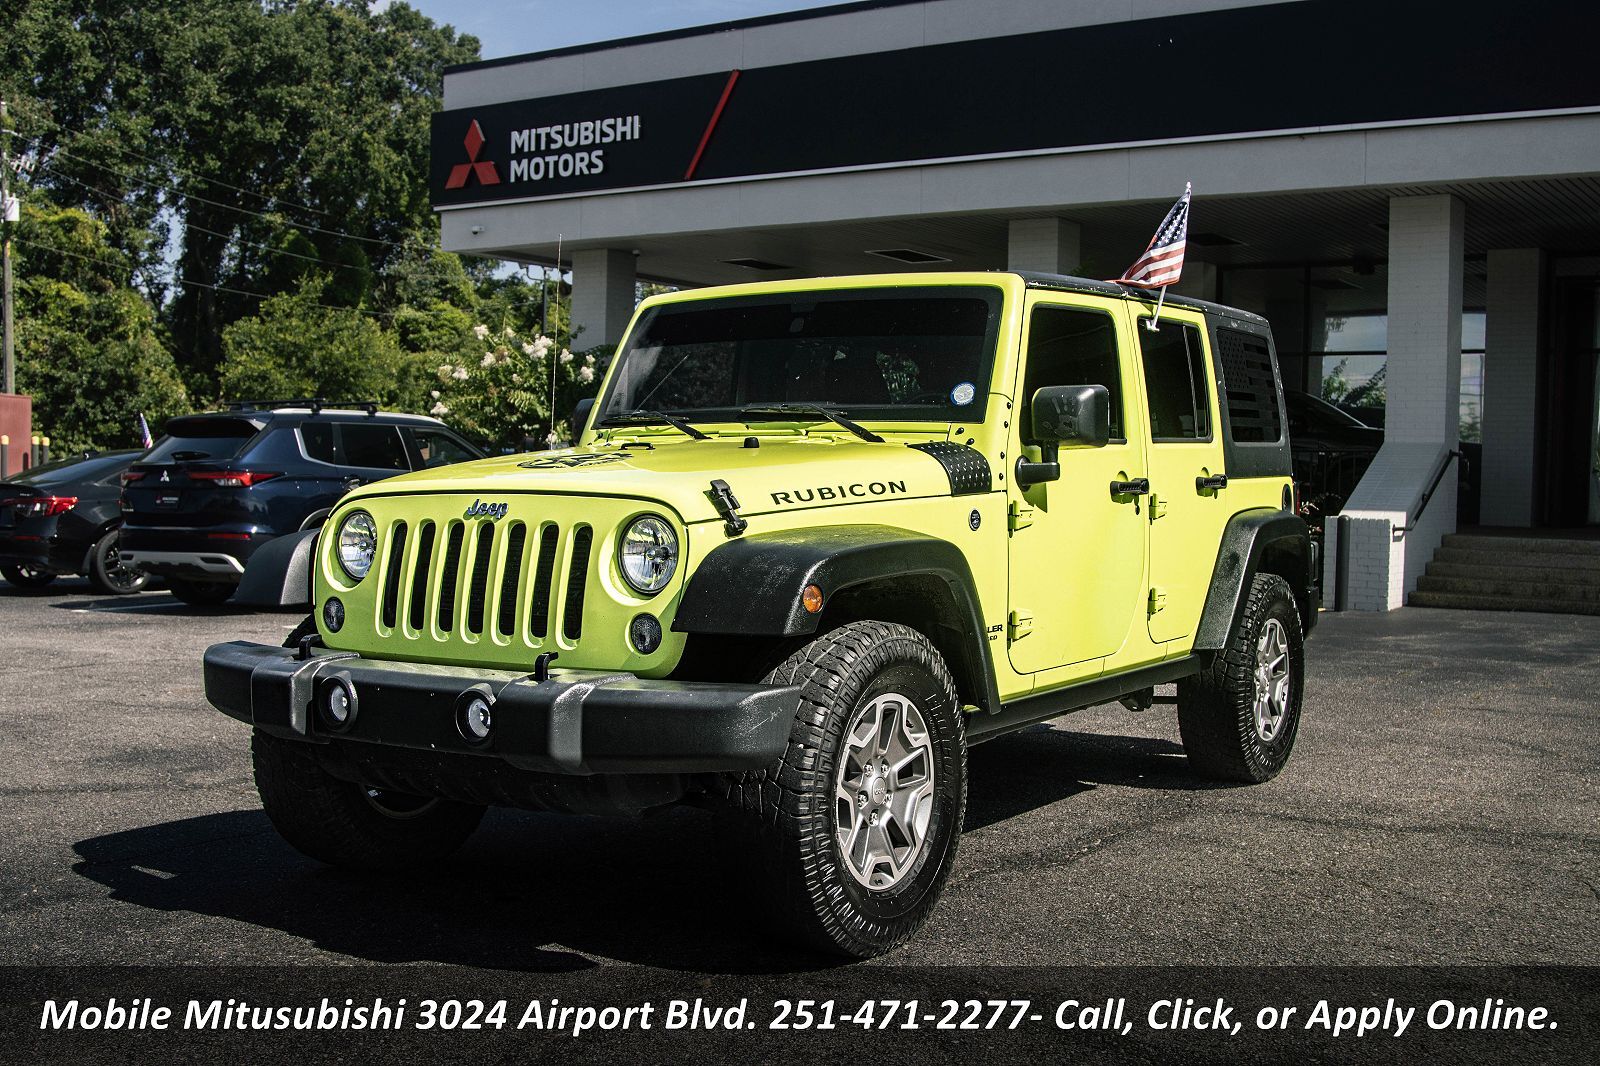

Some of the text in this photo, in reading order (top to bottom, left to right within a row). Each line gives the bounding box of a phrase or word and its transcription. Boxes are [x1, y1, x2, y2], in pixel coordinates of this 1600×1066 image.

[510, 115, 640, 154] MITSUBISHI
[510, 150, 604, 183] MOTORS
[770, 480, 907, 505] RUBICON
[466, 498, 509, 519] Jeep
